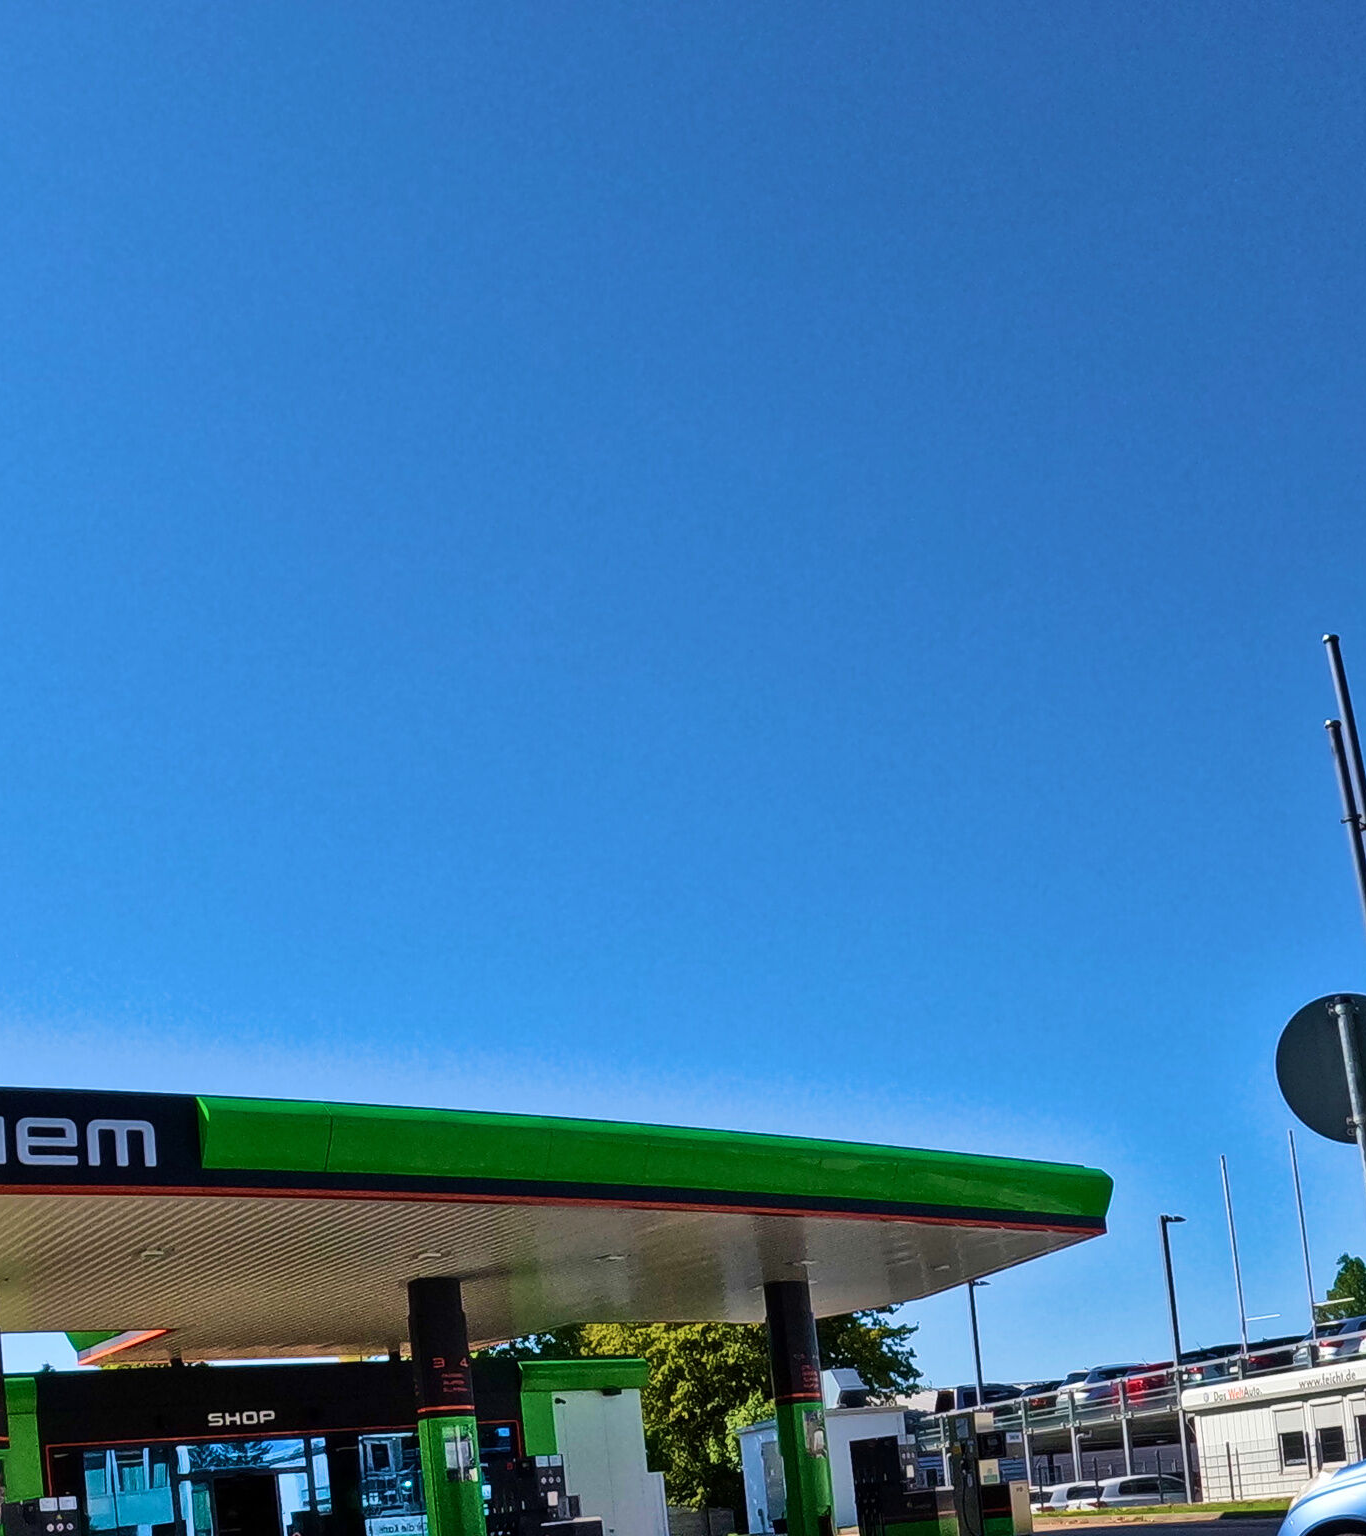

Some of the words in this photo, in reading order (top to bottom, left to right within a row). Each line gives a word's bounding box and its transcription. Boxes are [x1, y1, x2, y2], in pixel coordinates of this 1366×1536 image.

[432, 1357, 445, 1368] 3
[1298, 1369, 1357, 1389] www.feicht.de
[207, 1410, 276, 1426] SHOP
